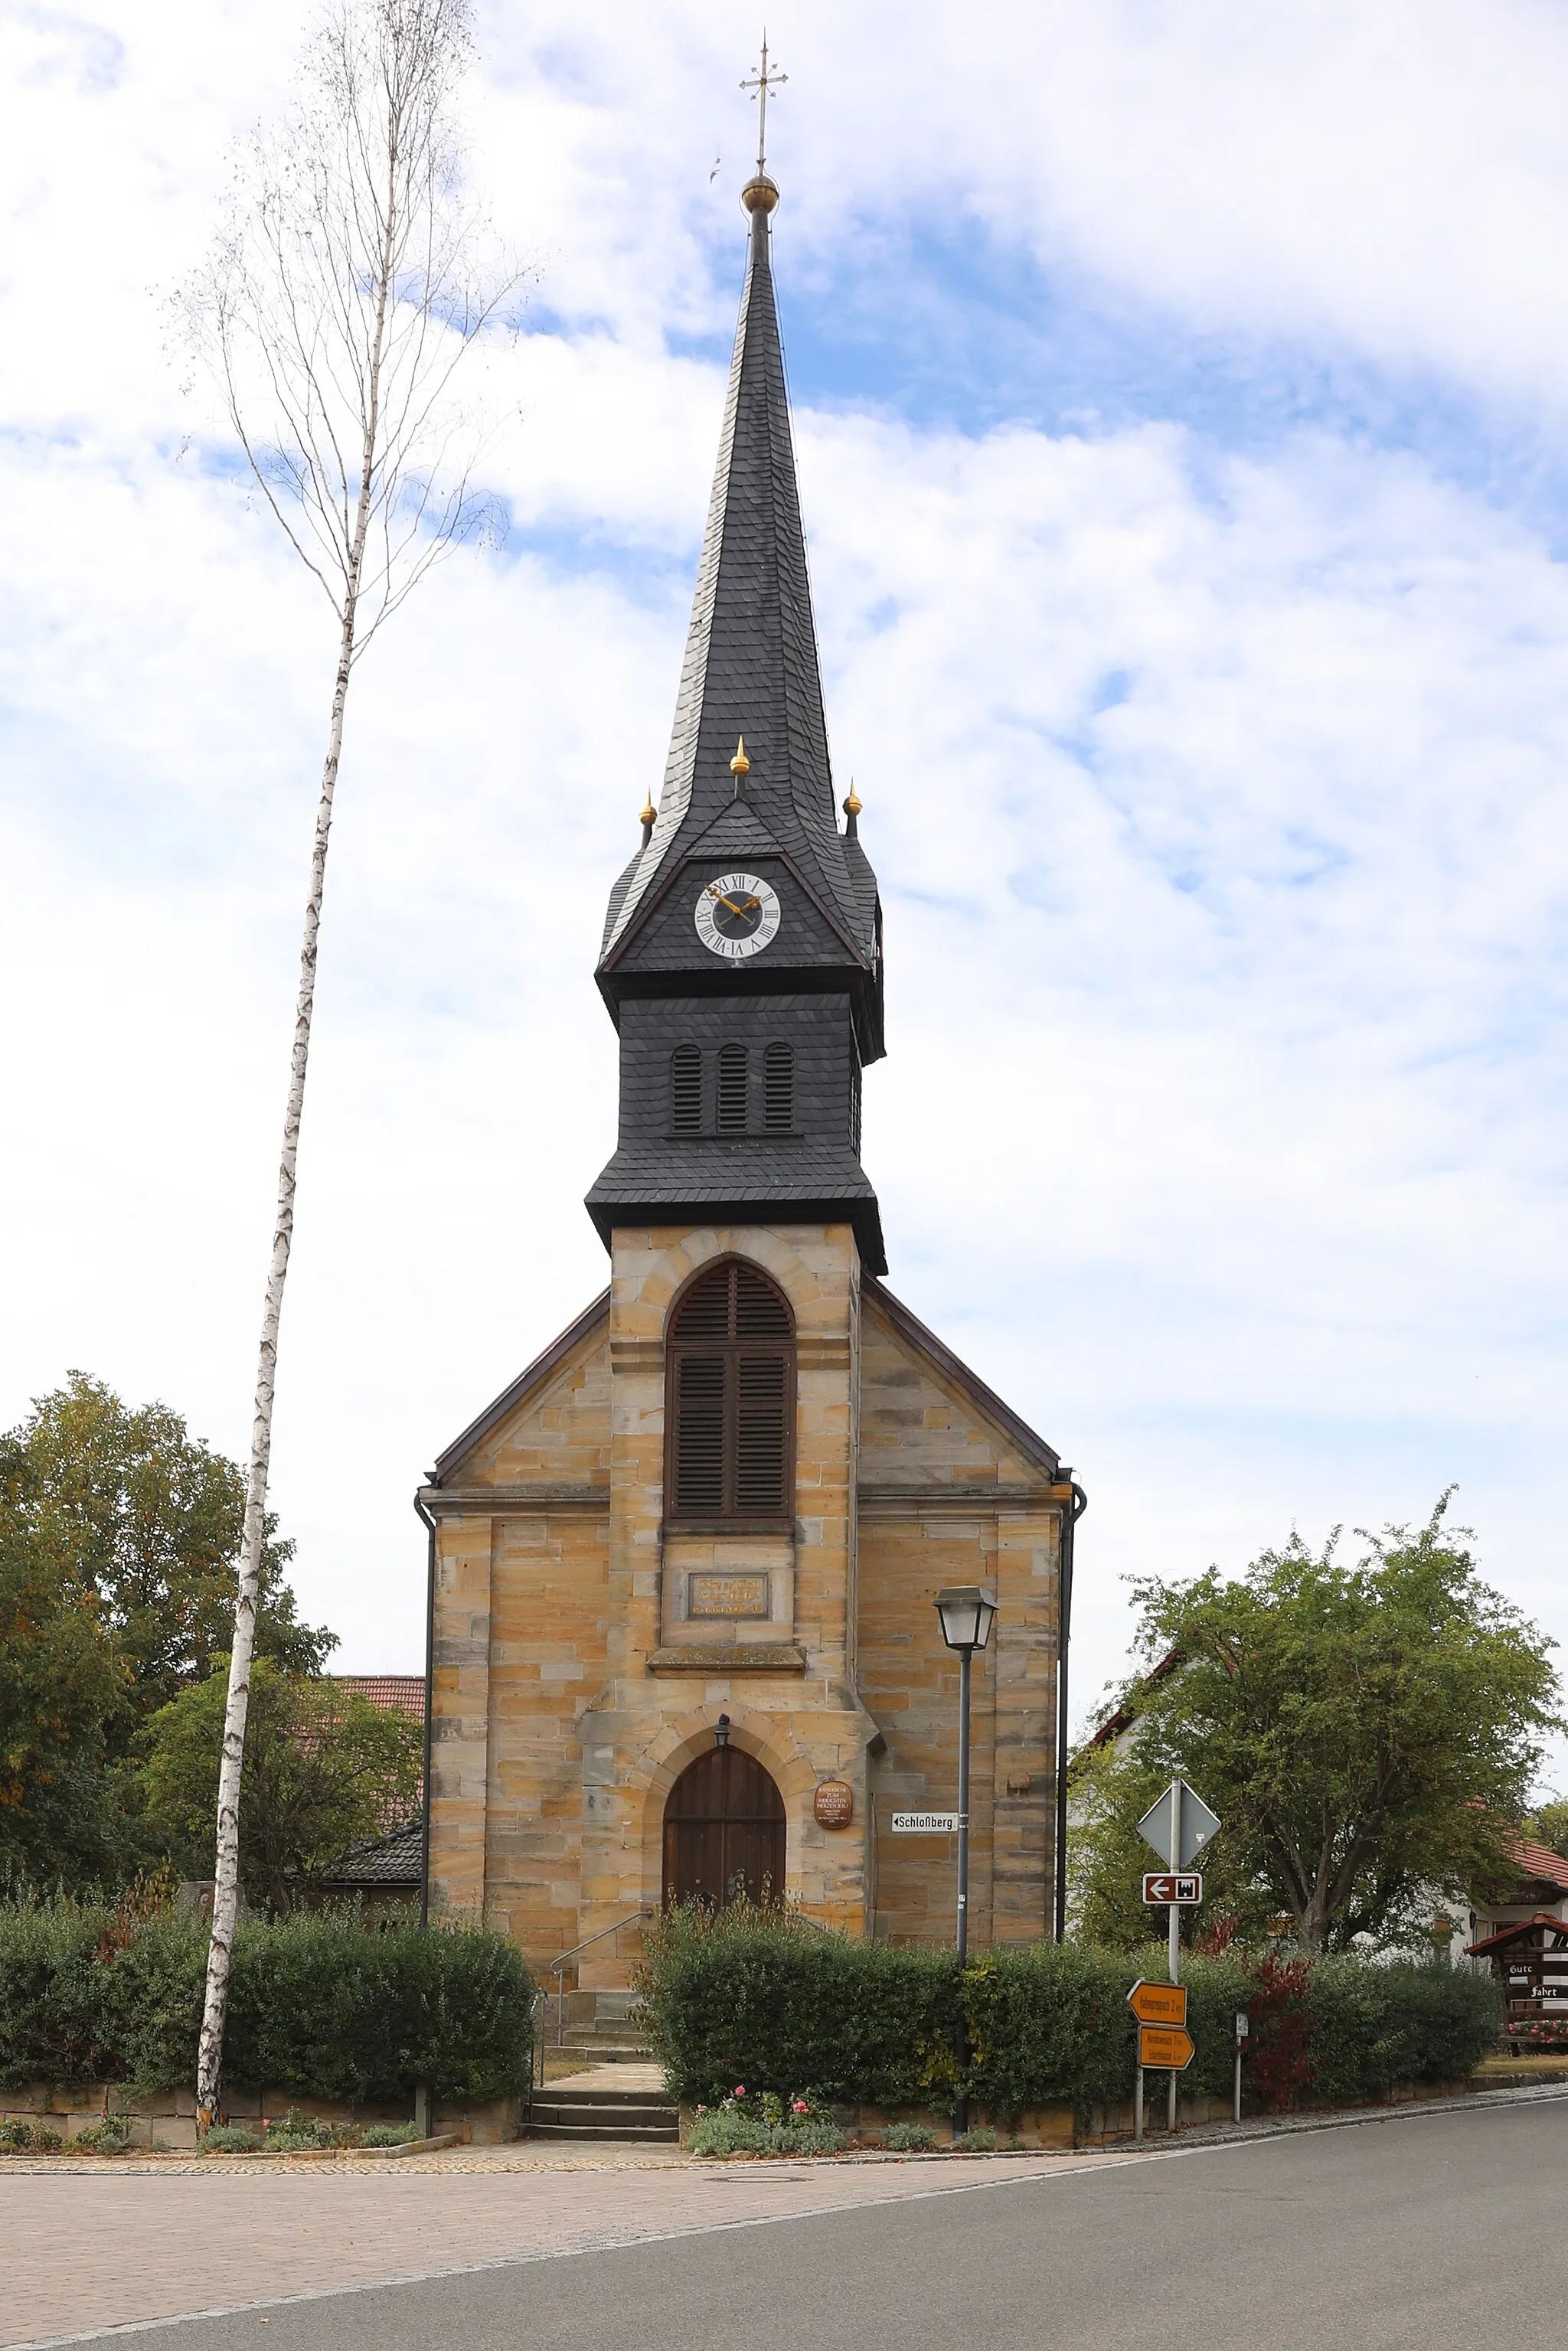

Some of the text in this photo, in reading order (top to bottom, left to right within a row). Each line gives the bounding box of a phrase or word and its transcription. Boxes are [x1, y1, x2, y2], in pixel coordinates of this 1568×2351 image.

[714, 879, 729, 893] XI
[731, 876, 745, 890] XII
[751, 880, 760, 892] I
[701, 893, 717, 906] X
[761, 892, 775, 903] II
[697, 911, 711, 922] IX
[765, 910, 779, 919] III
[700, 925, 714, 943] VIII
[759, 924, 775, 939] IIII
[713, 938, 725, 954] VII
[731, 942, 743, 955] VI
[751, 939, 761, 952] V
[899, 1817, 952, 1830] Schloßberg
[1531, 1986, 1557, 1997] Fahrt
[1171, 1999, 1176, 2012] 2
